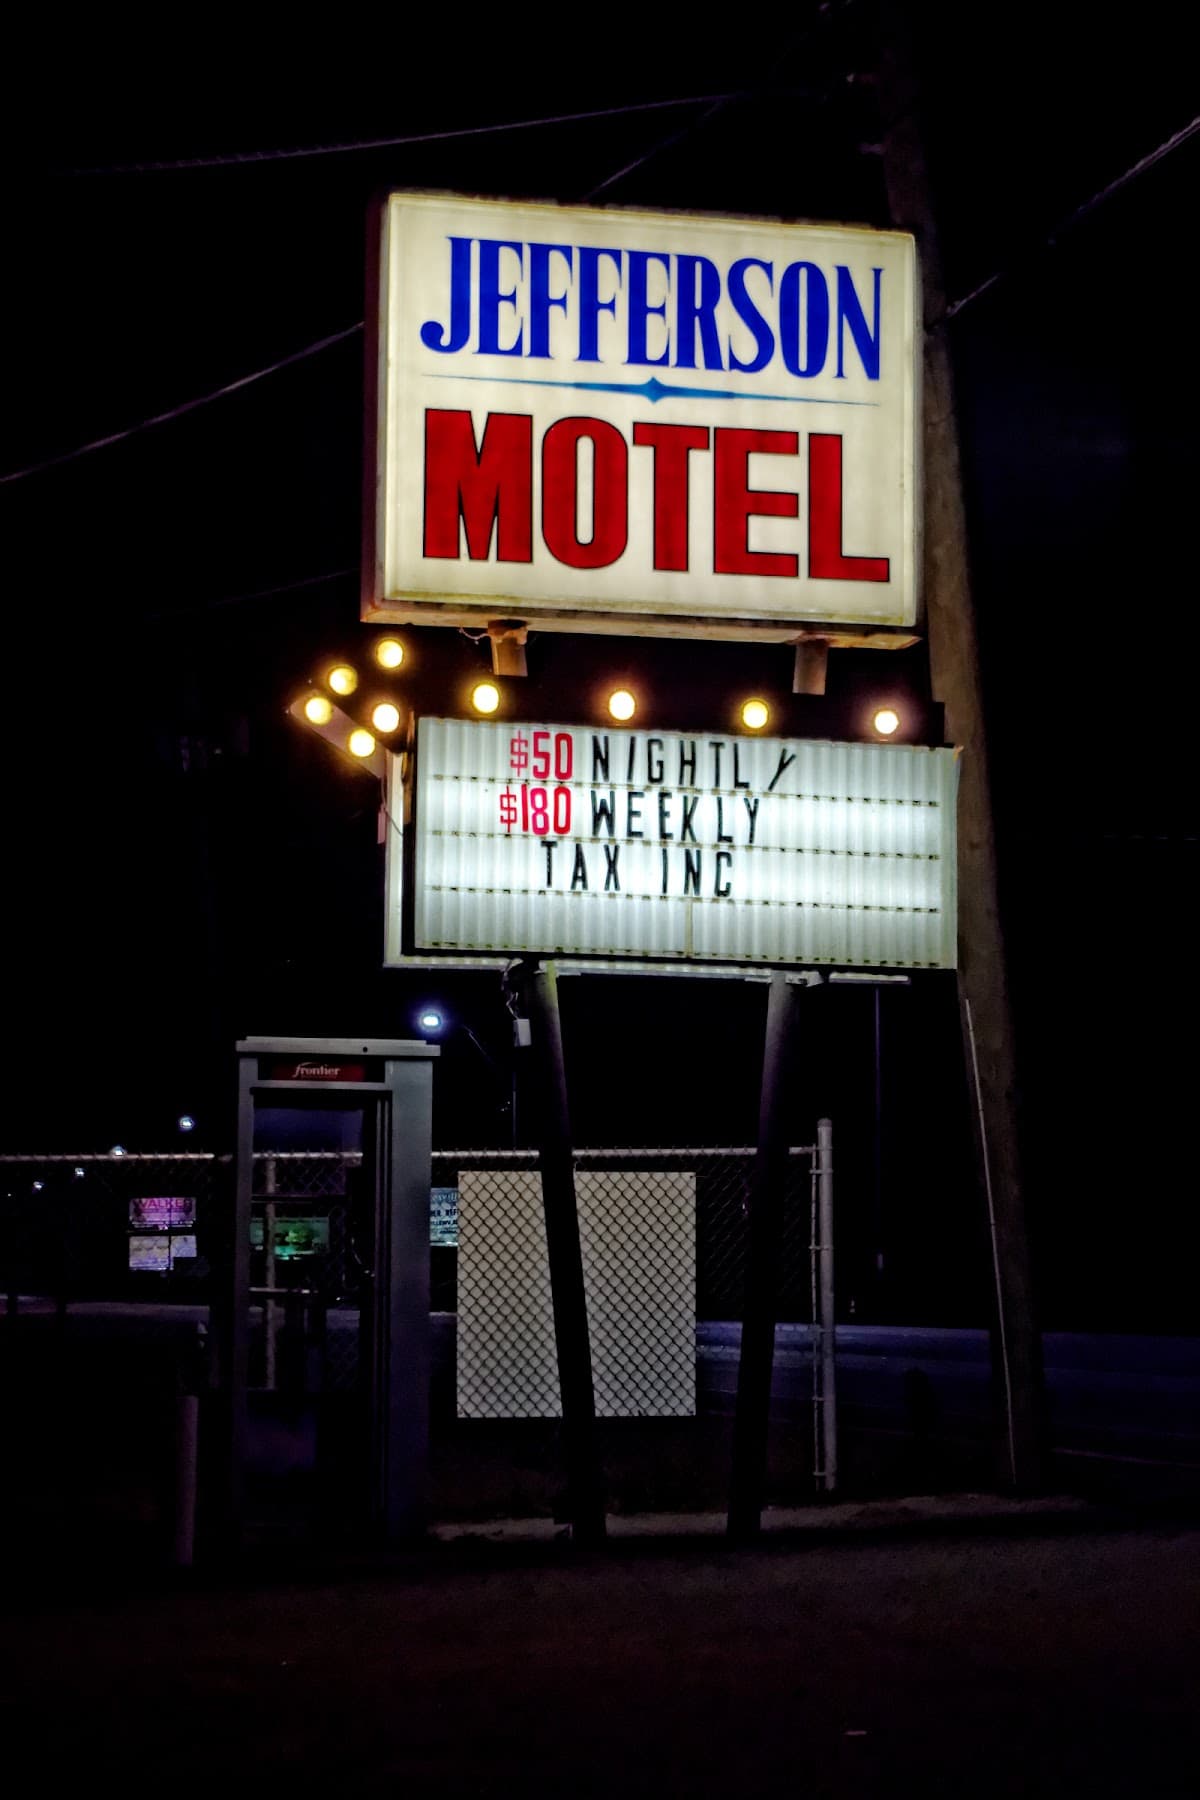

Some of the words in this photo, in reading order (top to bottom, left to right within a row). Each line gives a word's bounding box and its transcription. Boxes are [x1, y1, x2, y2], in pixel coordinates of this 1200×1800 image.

[420, 236, 883, 381] JEFFERSON
[422, 408, 890, 582] MOTEL
[510, 730, 573, 781] $50
[592, 735, 796, 792] NIGHTLY
[500, 784, 572, 836] $180
[591, 790, 759, 844] WEEKLY
[541, 840, 621, 891] TAX
[662, 848, 733, 897] INC
[292, 1062, 341, 1077] frontier
